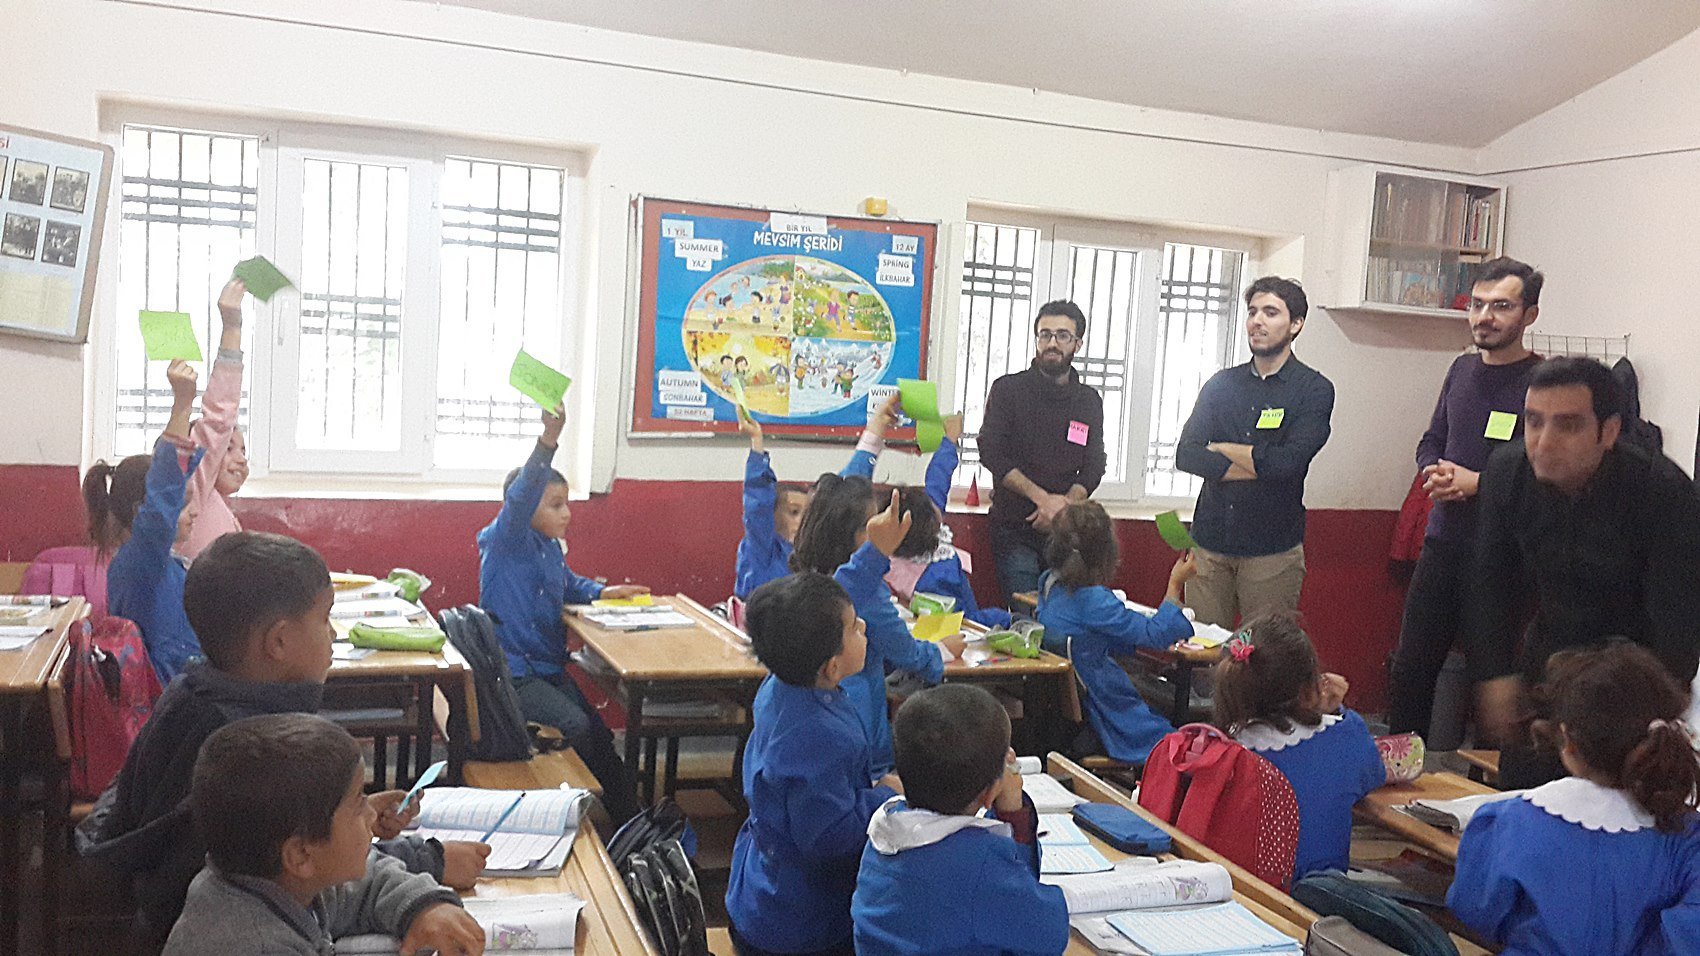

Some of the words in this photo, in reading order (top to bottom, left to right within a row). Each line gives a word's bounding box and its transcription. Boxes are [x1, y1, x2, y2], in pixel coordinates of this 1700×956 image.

[800, 225, 813, 233] YIL
[679, 242, 719, 253] SUMMER
[803, 234, 843, 253] ŞERİDİ
[896, 243, 904, 251] 12
[691, 259, 707, 268] YAZ
[660, 378, 699, 388] AUTUMN
